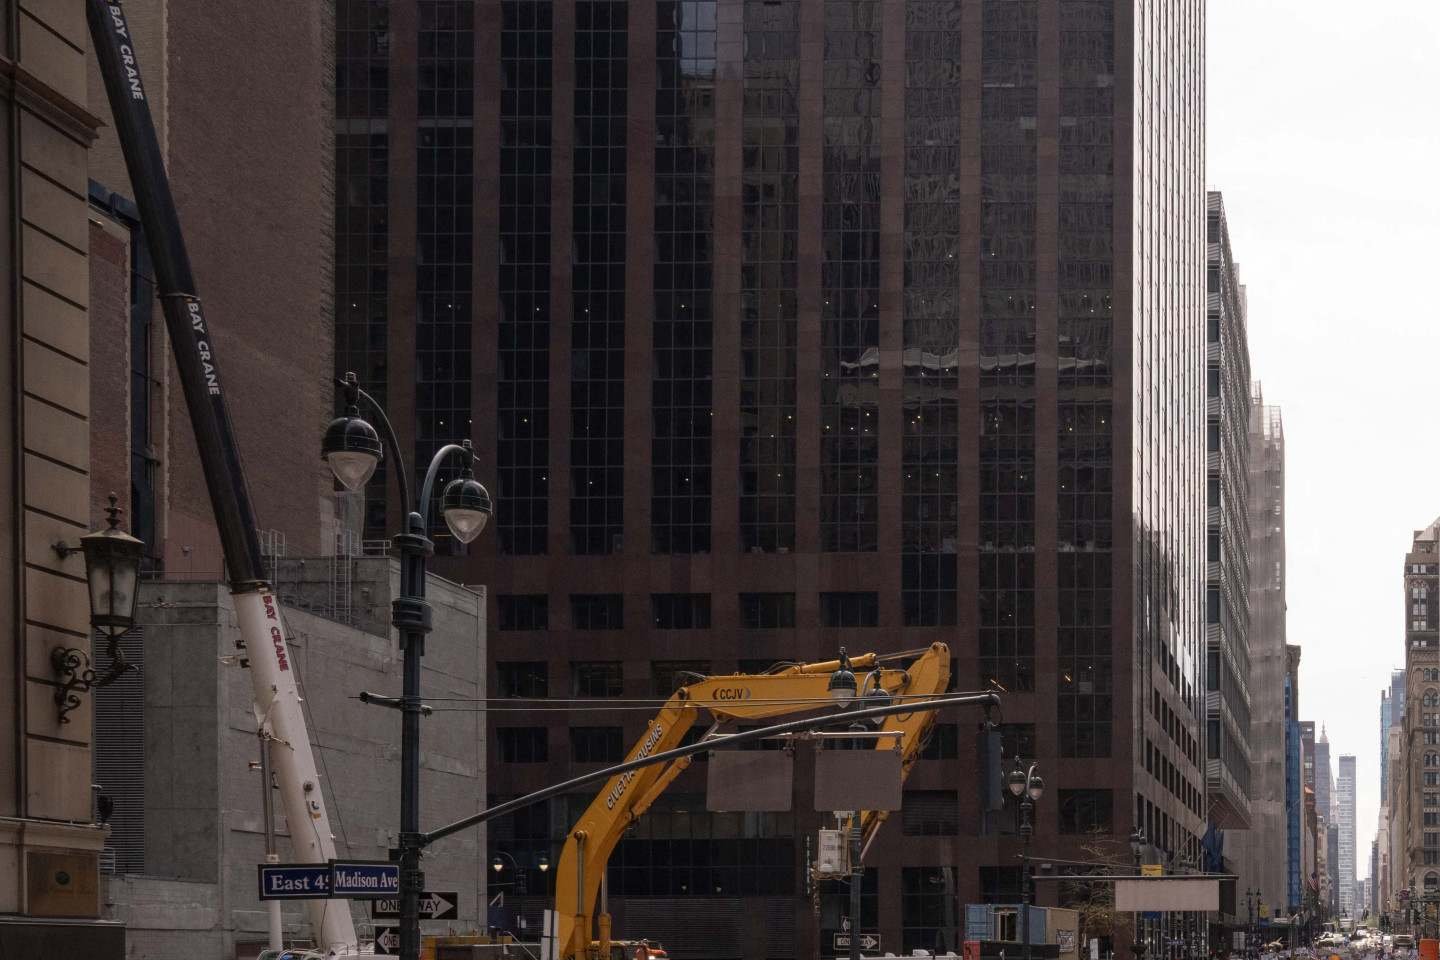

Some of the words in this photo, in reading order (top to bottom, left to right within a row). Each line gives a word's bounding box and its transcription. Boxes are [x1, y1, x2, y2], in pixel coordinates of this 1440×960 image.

[109, 5, 127, 39] BAY
[120, 44, 144, 101] CRANE
[187, 302, 205, 334] BAY
[198, 341, 220, 395] CRANE
[262, 595, 277, 620] BAY
[270, 626, 289, 671] CRANE
[719, 688, 743, 700] CCJV
[270, 874, 310, 891] East
[335, 871, 378, 889] Madison
[379, 873, 398, 888] Ave
[380, 900, 401, 911] ONE
